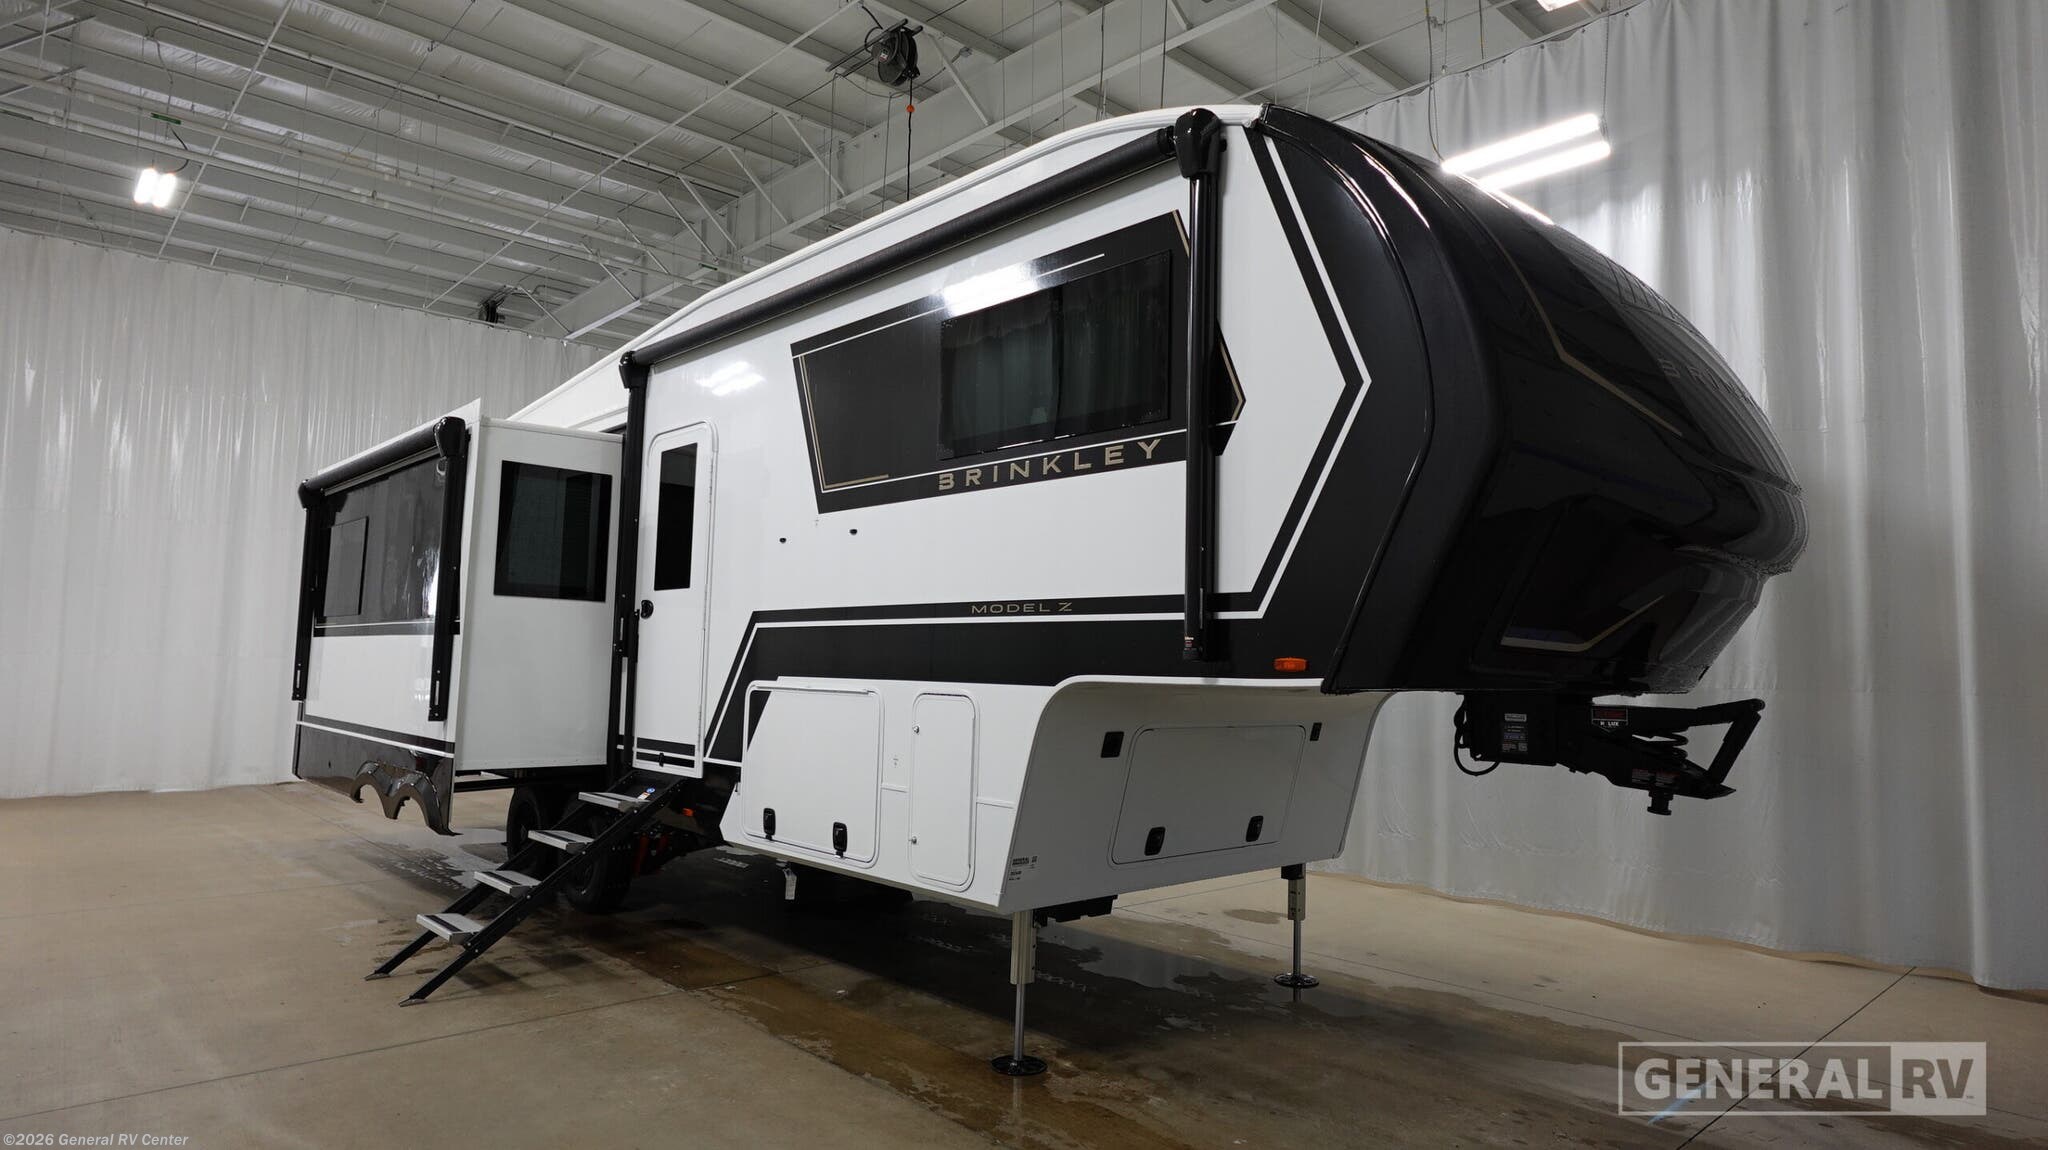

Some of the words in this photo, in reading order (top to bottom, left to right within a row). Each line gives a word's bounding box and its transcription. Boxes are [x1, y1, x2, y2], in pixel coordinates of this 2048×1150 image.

[938, 438, 1162, 491] BRINKLEY
[971, 603, 1051, 614] MODEL
[1058, 602, 1073, 612] Z
